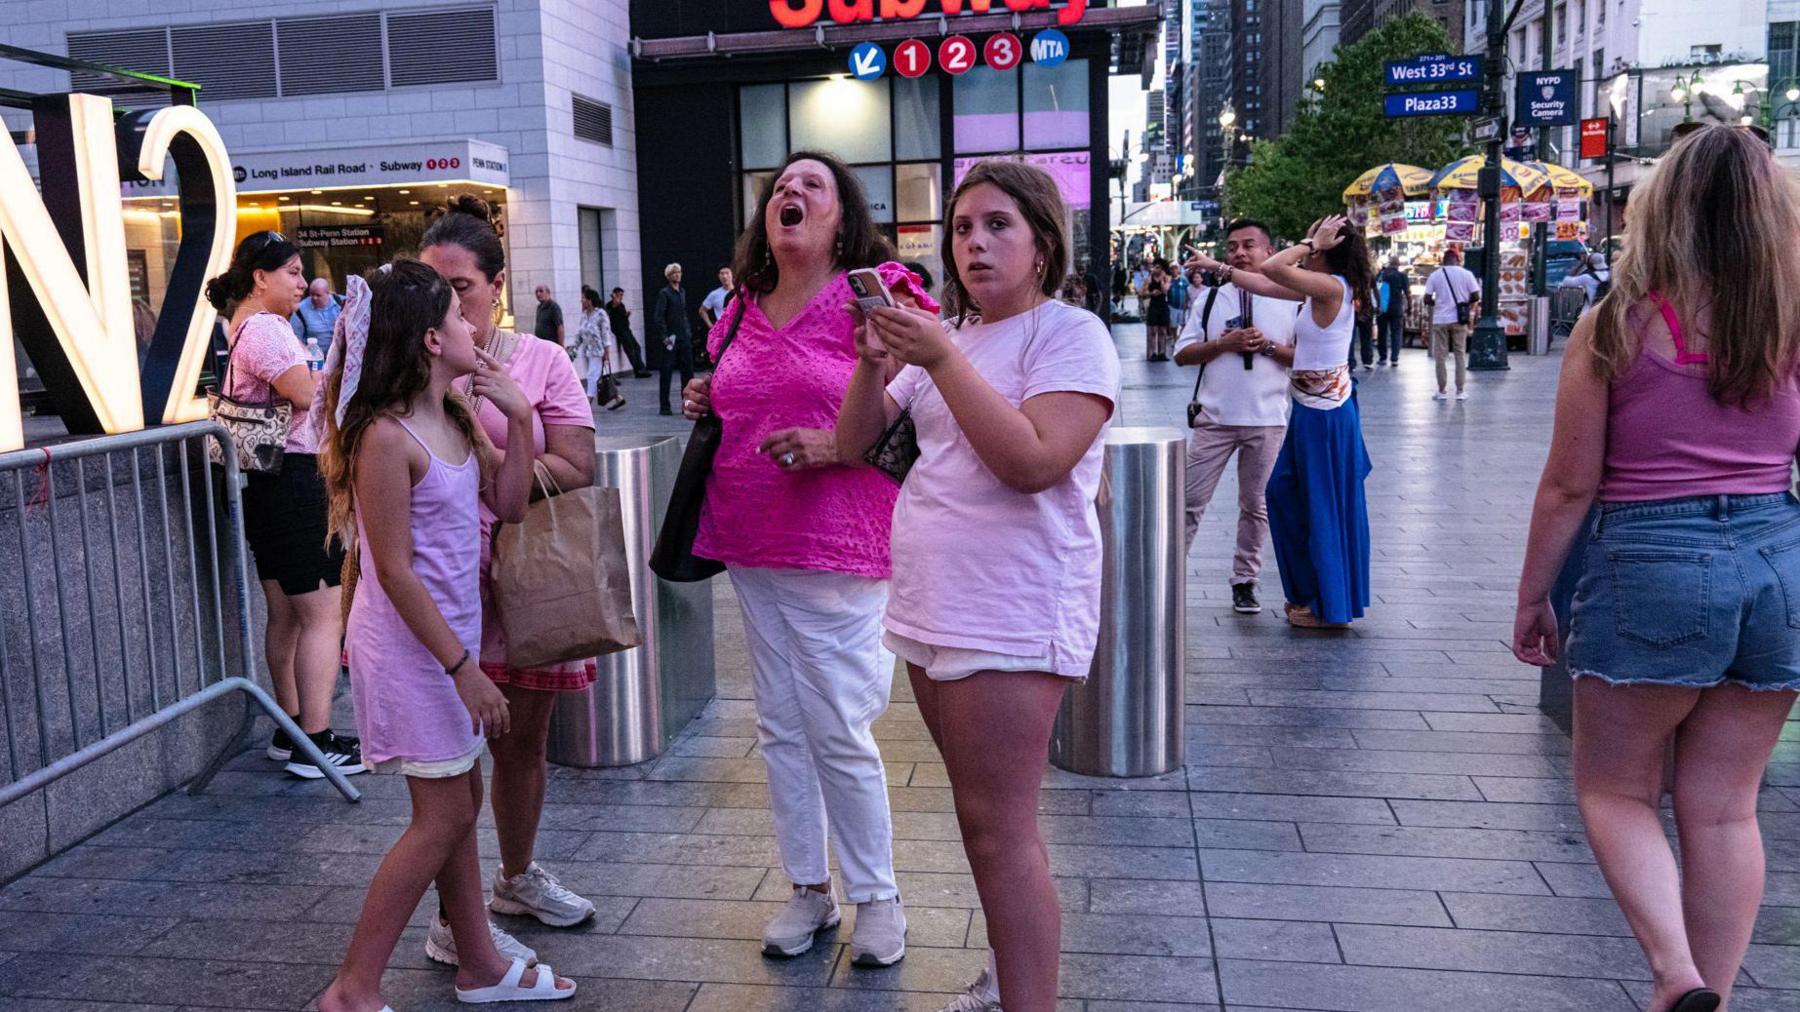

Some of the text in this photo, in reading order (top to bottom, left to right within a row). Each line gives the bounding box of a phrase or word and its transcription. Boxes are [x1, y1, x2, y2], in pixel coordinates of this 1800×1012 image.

[770, 0, 1087, 27] Suy
[948, 42, 967, 68] 2
[993, 38, 1013, 65] 3
[1030, 38, 1063, 61] MTA
[1392, 62, 1472, 79] West 33rd St
[1536, 77, 1560, 85] NYPD
[1405, 96, 1457, 111] Plaza33
[1531, 101, 1565, 109] Security
[1531, 109, 1564, 117] Camera
[252, 169, 278, 180] Long
[281, 166, 312, 177] Island
[315, 165, 335, 175] Rail
[338, 163, 366, 173] Road
[380, 161, 423, 172] Subway
[342, 228, 370, 236] Station
[331, 238, 359, 246] Station
